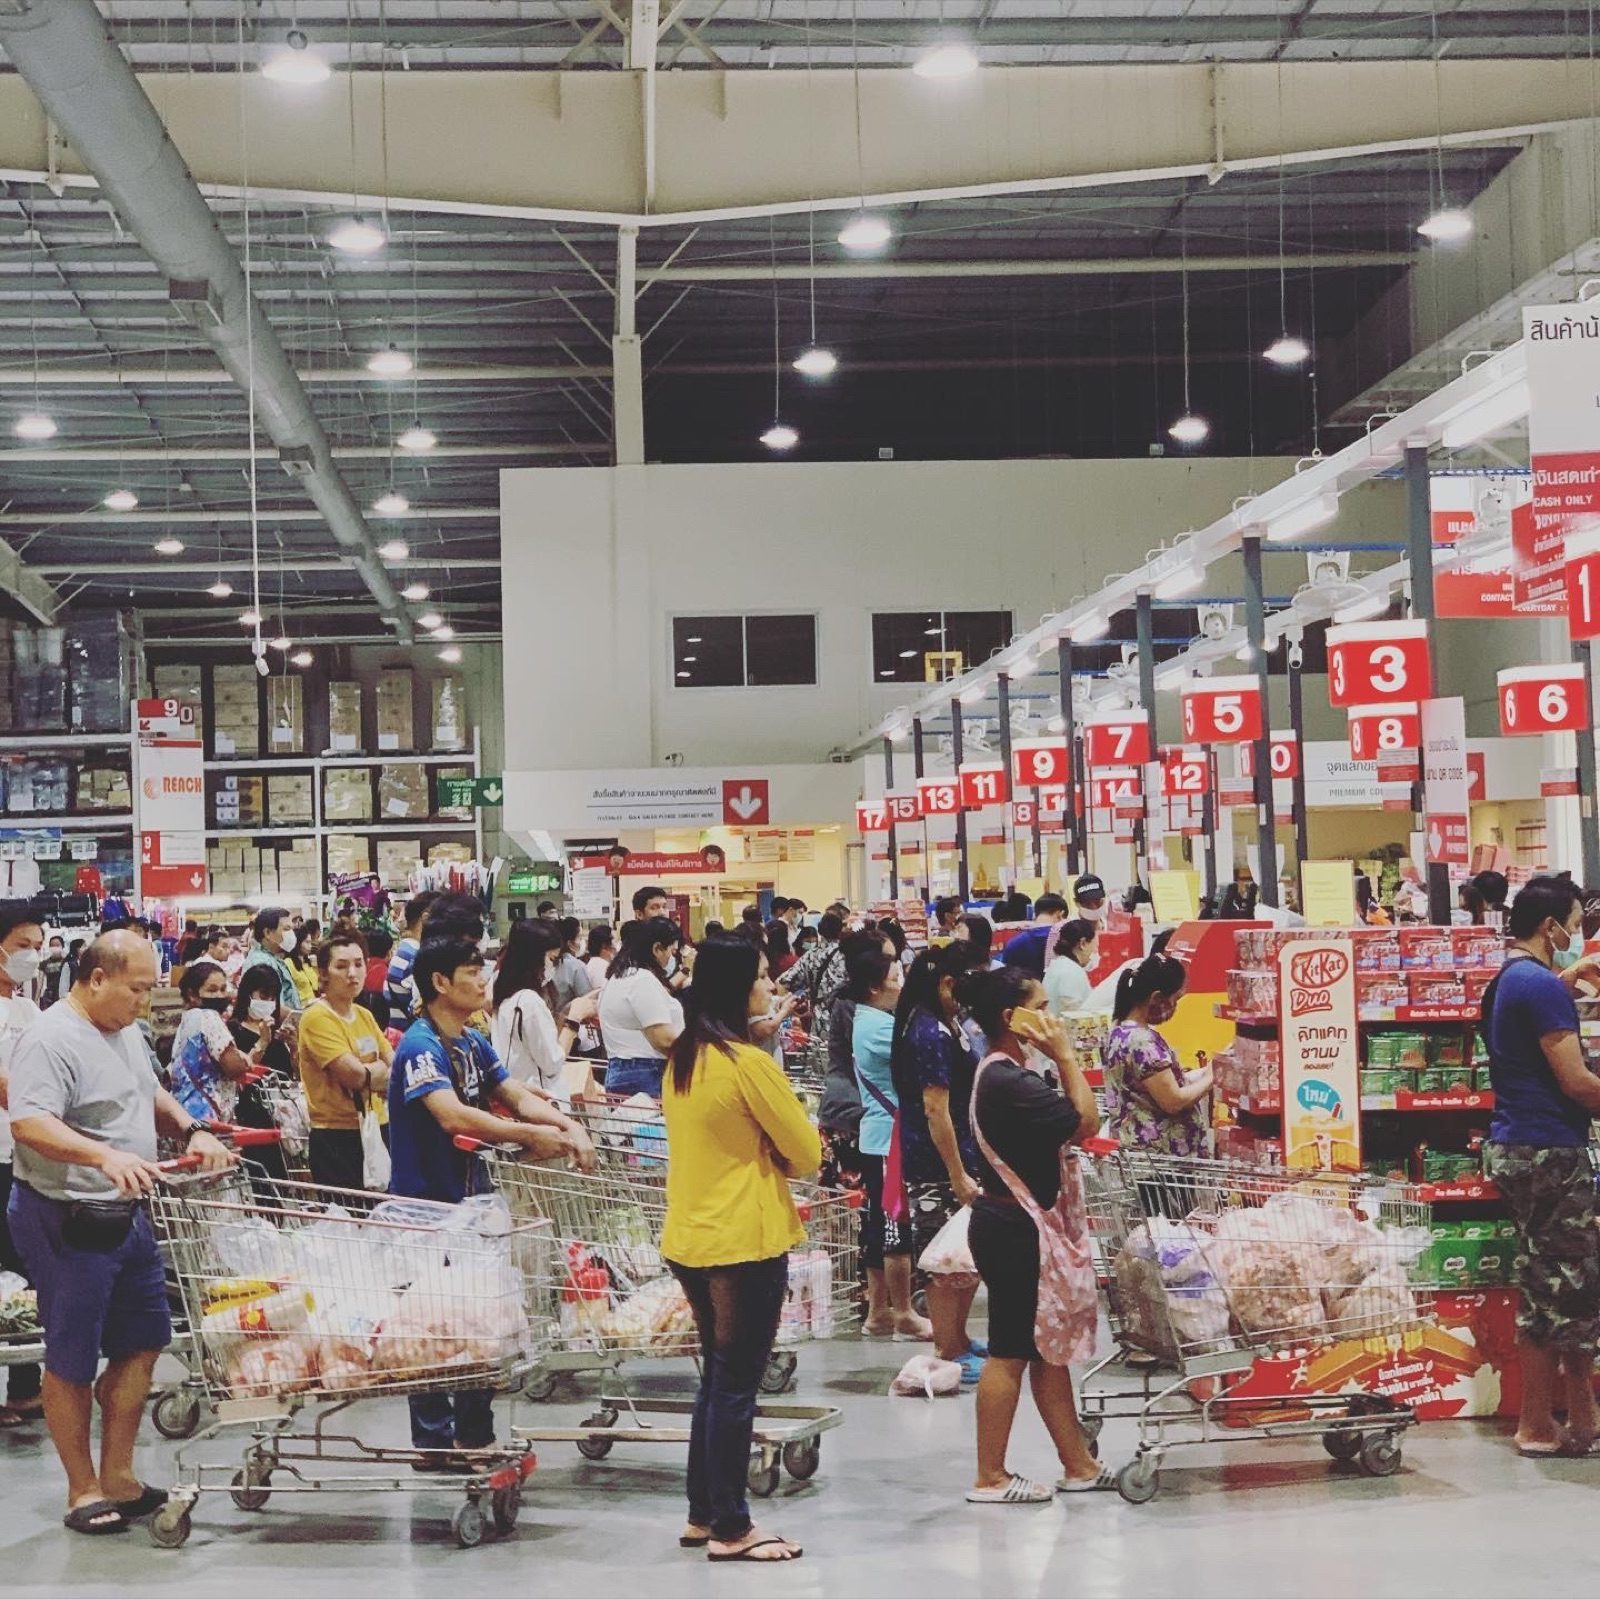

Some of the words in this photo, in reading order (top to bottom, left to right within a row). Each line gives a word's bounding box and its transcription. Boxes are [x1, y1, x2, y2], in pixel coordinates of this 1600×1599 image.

[1534, 495, 1561, 507] CASH
[1565, 494, 1592, 506] ONLY
[1333, 650, 1345, 696] 3
[1369, 645, 1407, 693] 3
[163, 699, 178, 717] 9
[1213, 695, 1244, 734] 5
[1504, 688, 1517, 727] 6
[1538, 683, 1569, 723] 6
[1184, 698, 1195, 737] 5
[1107, 726, 1133, 759] 7
[1378, 718, 1405, 749] 8
[1033, 750, 1055, 779] 9
[1169, 765, 1202, 790] 12
[926, 786, 955, 810] 13
[972, 773, 996, 800] 11
[1105, 780, 1132, 803] 14
[1329, 788, 1366, 797] PREMIUM
[862, 809, 884, 829] 17
[889, 798, 915, 818] 15
[143, 836, 152, 849] 9
[1301, 952, 1342, 985] KitKat
[1291, 989, 1331, 1011] Duo
[1301, 1046, 1340, 1060] ชานม
